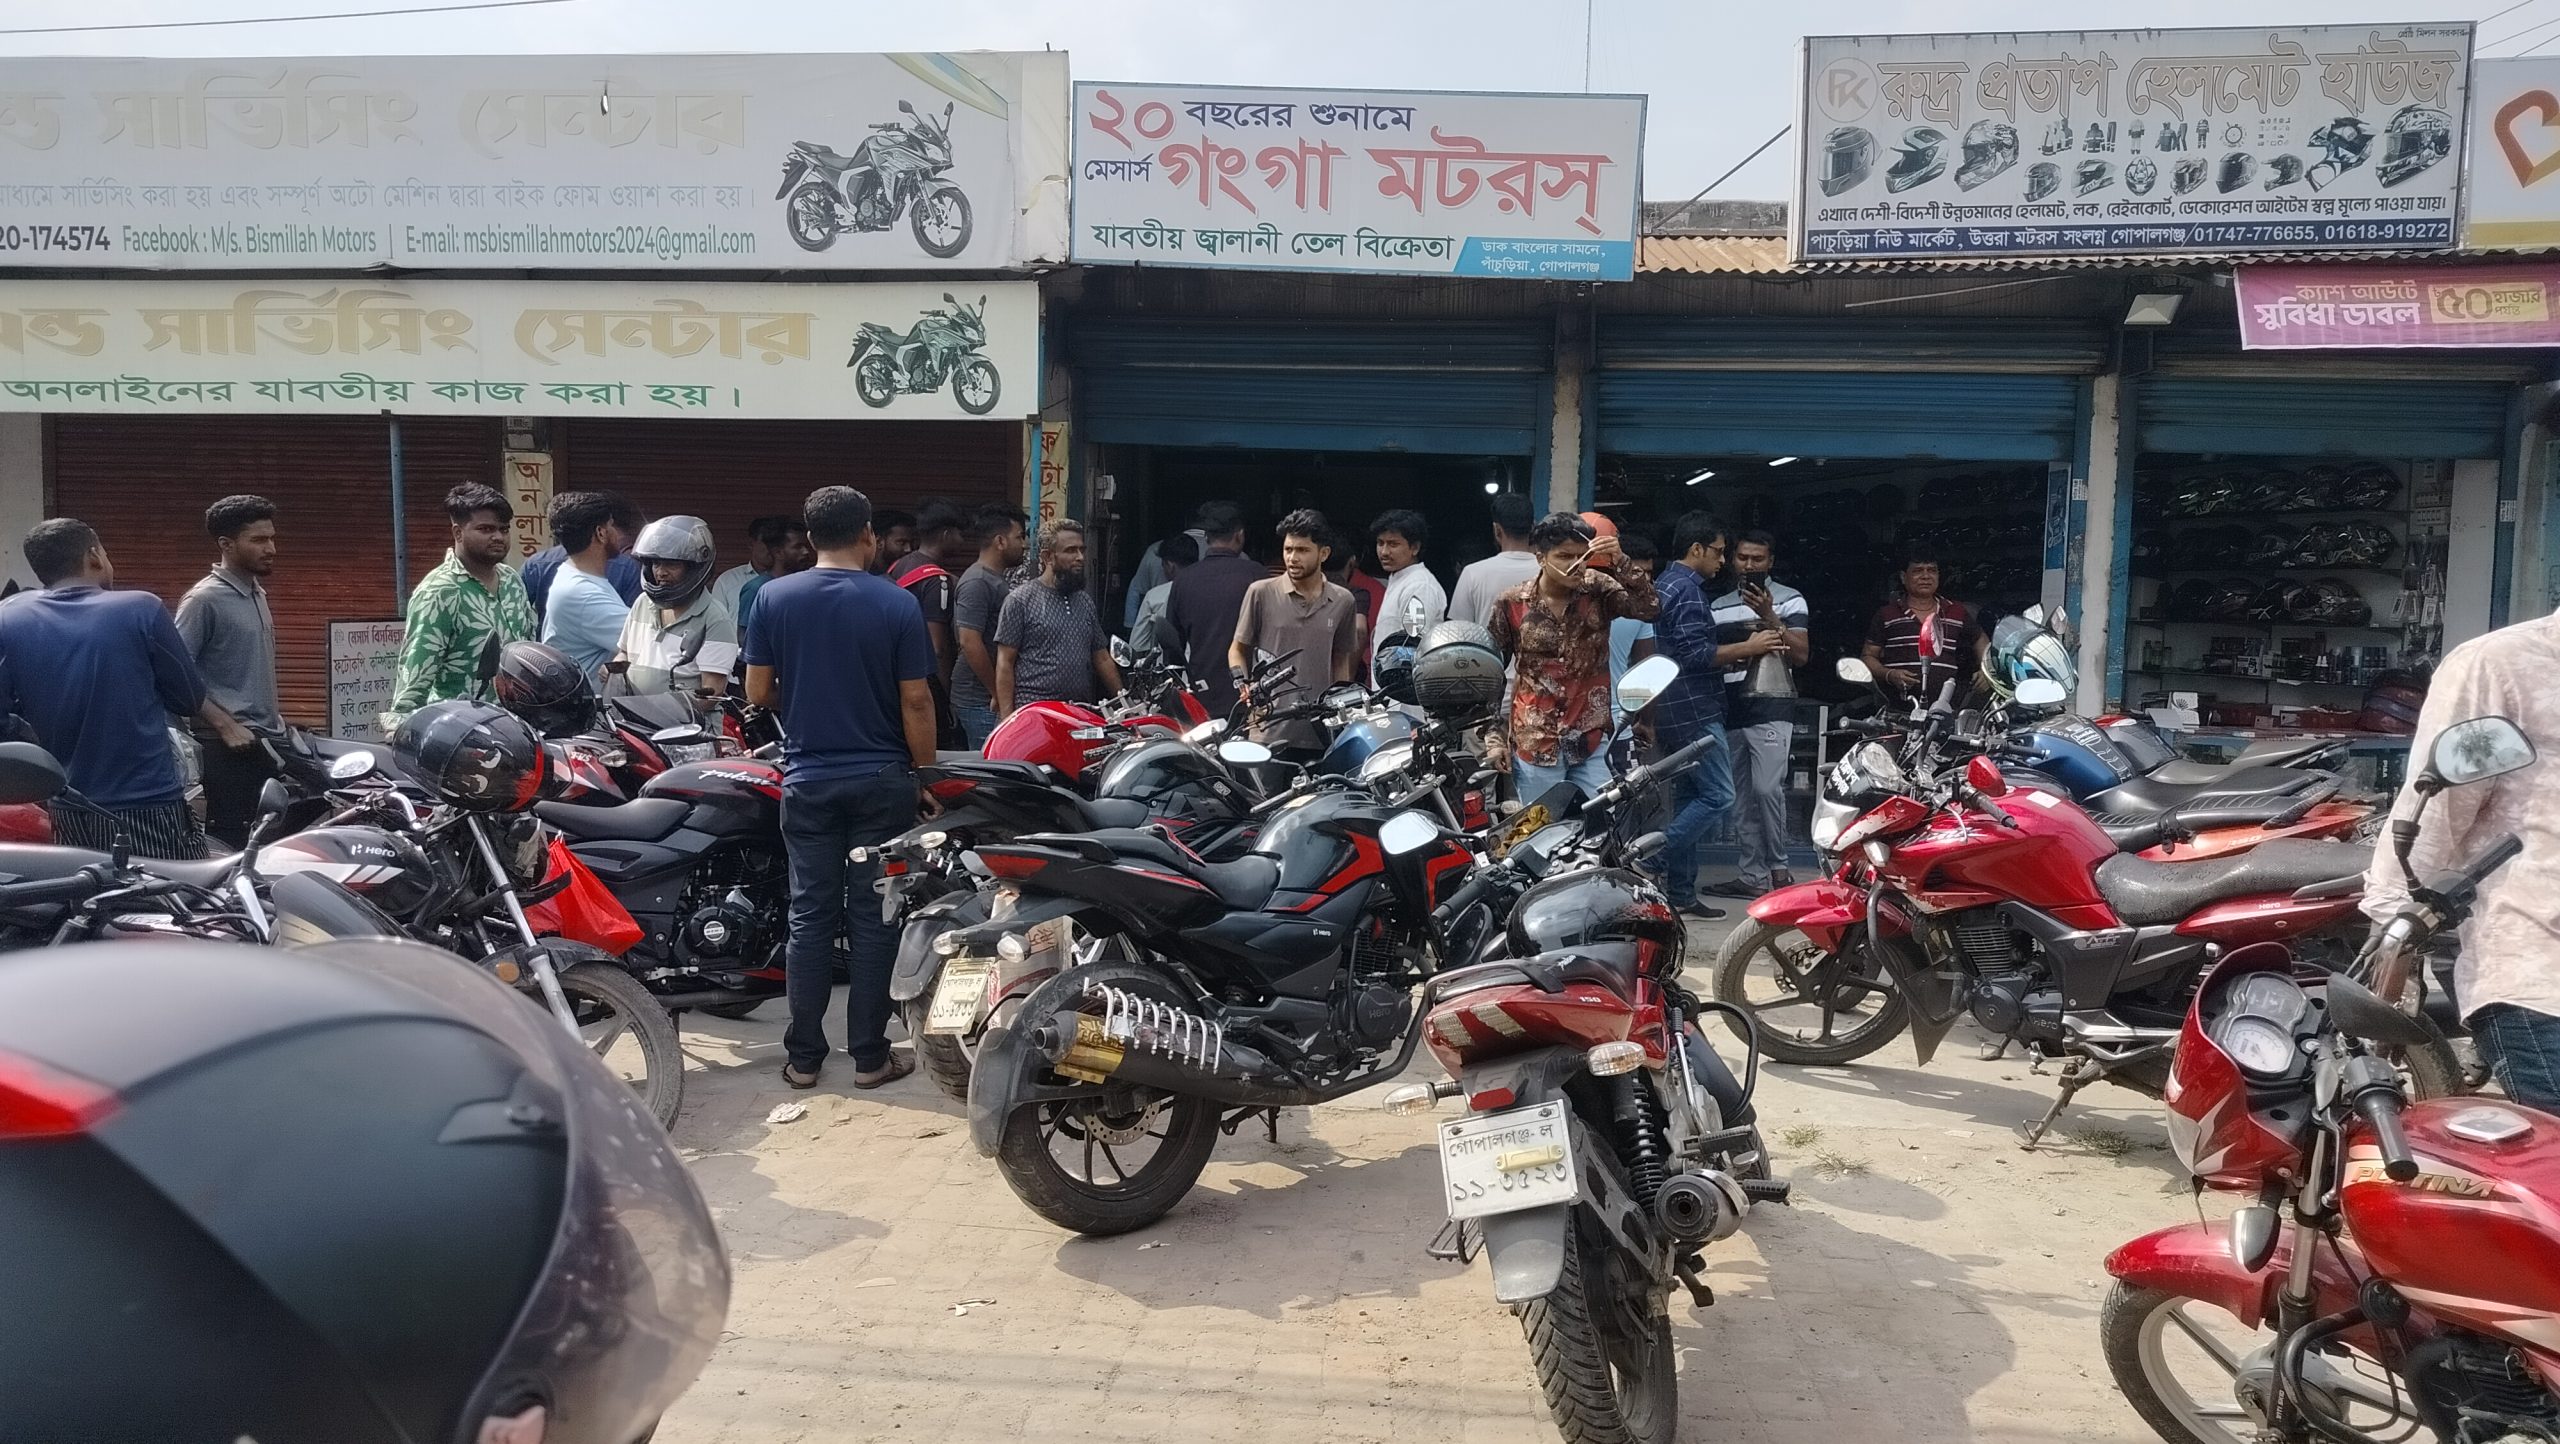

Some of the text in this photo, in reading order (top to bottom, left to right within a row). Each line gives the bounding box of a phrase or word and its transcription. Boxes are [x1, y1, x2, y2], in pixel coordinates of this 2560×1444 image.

[1877, 31, 2461, 130] রুদ্র প্রতাপ হেলমেট হাউজ
[91, 66, 423, 151] সার্ভিসিং
[459, 79, 753, 160] সেন্টার
[1089, 90, 1174, 149] ২০
[1183, 101, 1296, 130] বছরের
[1084, 125, 1616, 236] মেসার্স গংগা মটরস্
[61, 176, 135, 208] সার্ভিসিং
[140, 184, 177, 208] করা
[184, 184, 212, 210] হয়
[221, 185, 261, 208] এবং
[266, 176, 322, 215] সম্পূর্ণ
[328, 179, 375, 208] অটো
[384, 177, 441, 208] মেশিন
[448, 184, 486, 208] দ্বারা
[493, 180, 545, 208] বাইক
[554, 184, 600, 208] ফোম
[609, 184, 660, 208] ওয়াশ
[668, 184, 707, 208] করা
[713, 185, 743, 210] হয়
[1818, 206, 1858, 222] এখানে
[1861, 202, 1940, 221] দেশী-বিদেশী
[1942, 201, 2012, 223] উন্নতমানের
[2015, 200, 2070, 220] হেলমেট,
[2073, 203, 2103, 219] লক,
[2106, 196, 2176, 218] রেইনকোর্ট,
[2179, 197, 2253, 216] ডেকোরেশন
[2255, 195, 2308, 215] আইটেম
[2311, 199, 2335, 216] স্বল্প
[2338, 198, 2371, 218] মূল্যে
[2375, 197, 2414, 213] পাওয়া
[212, 221, 242, 257] M/s.
[247, 224, 317, 253] Bismillah
[322, 226, 376, 253] Motors
[406, 224, 459, 253] E-mail:
[464, 224, 756, 259] msbismillahmotors2024@gmail.com
[1091, 219, 1454, 260] যাবতীয় জ্বালানী তেল বিক্রেতা
[1481, 242, 1607, 258] ডাক বাংলোর সামনে,
[1810, 230, 1870, 253] পাচুড়িয়া
[1874, 228, 1903, 248] নিউ
[1909, 227, 1963, 250] মার্কেট,
[1968, 228, 2011, 247] উত্তরা
[2014, 228, 2059, 245] মটরস
[2063, 229, 2107, 246] সংলগ্ন
[2325, 224, 2447, 240] 01618-919272
[1539, 260, 1600, 275] গোপালগঞ্জ
[2296, 280, 2418, 301] ক্যাশ আউটে
[2492, 289, 2543, 304] হাজার
[137, 288, 478, 356] সার্ভিসিং
[515, 299, 820, 365] সেন্টার
[2254, 297, 2420, 330] সুবিধা ডাবল
[2, 373, 238, 405] অনলাইনের
[249, 372, 416, 405] যাবতীয়
[427, 377, 529, 405] কাজ
[544, 380, 632, 408] করা
[644, 383, 716, 410] হয়
[347, 625, 370, 647] মেসার্স
[333, 676, 362, 697] পাসপোর্ট
[363, 680, 373, 693] এর
[340, 699, 355, 718] ছবি
[365, 846, 396, 858] Hero
[2258, 900, 2281, 910] Hero
[1368, 1008, 1391, 1020] Hero
[1579, 996, 1602, 1004] 150
[1453, 1163, 1567, 1201] ১১-৩৫২৩
[2352, 1166, 2497, 1198] PLTINA
